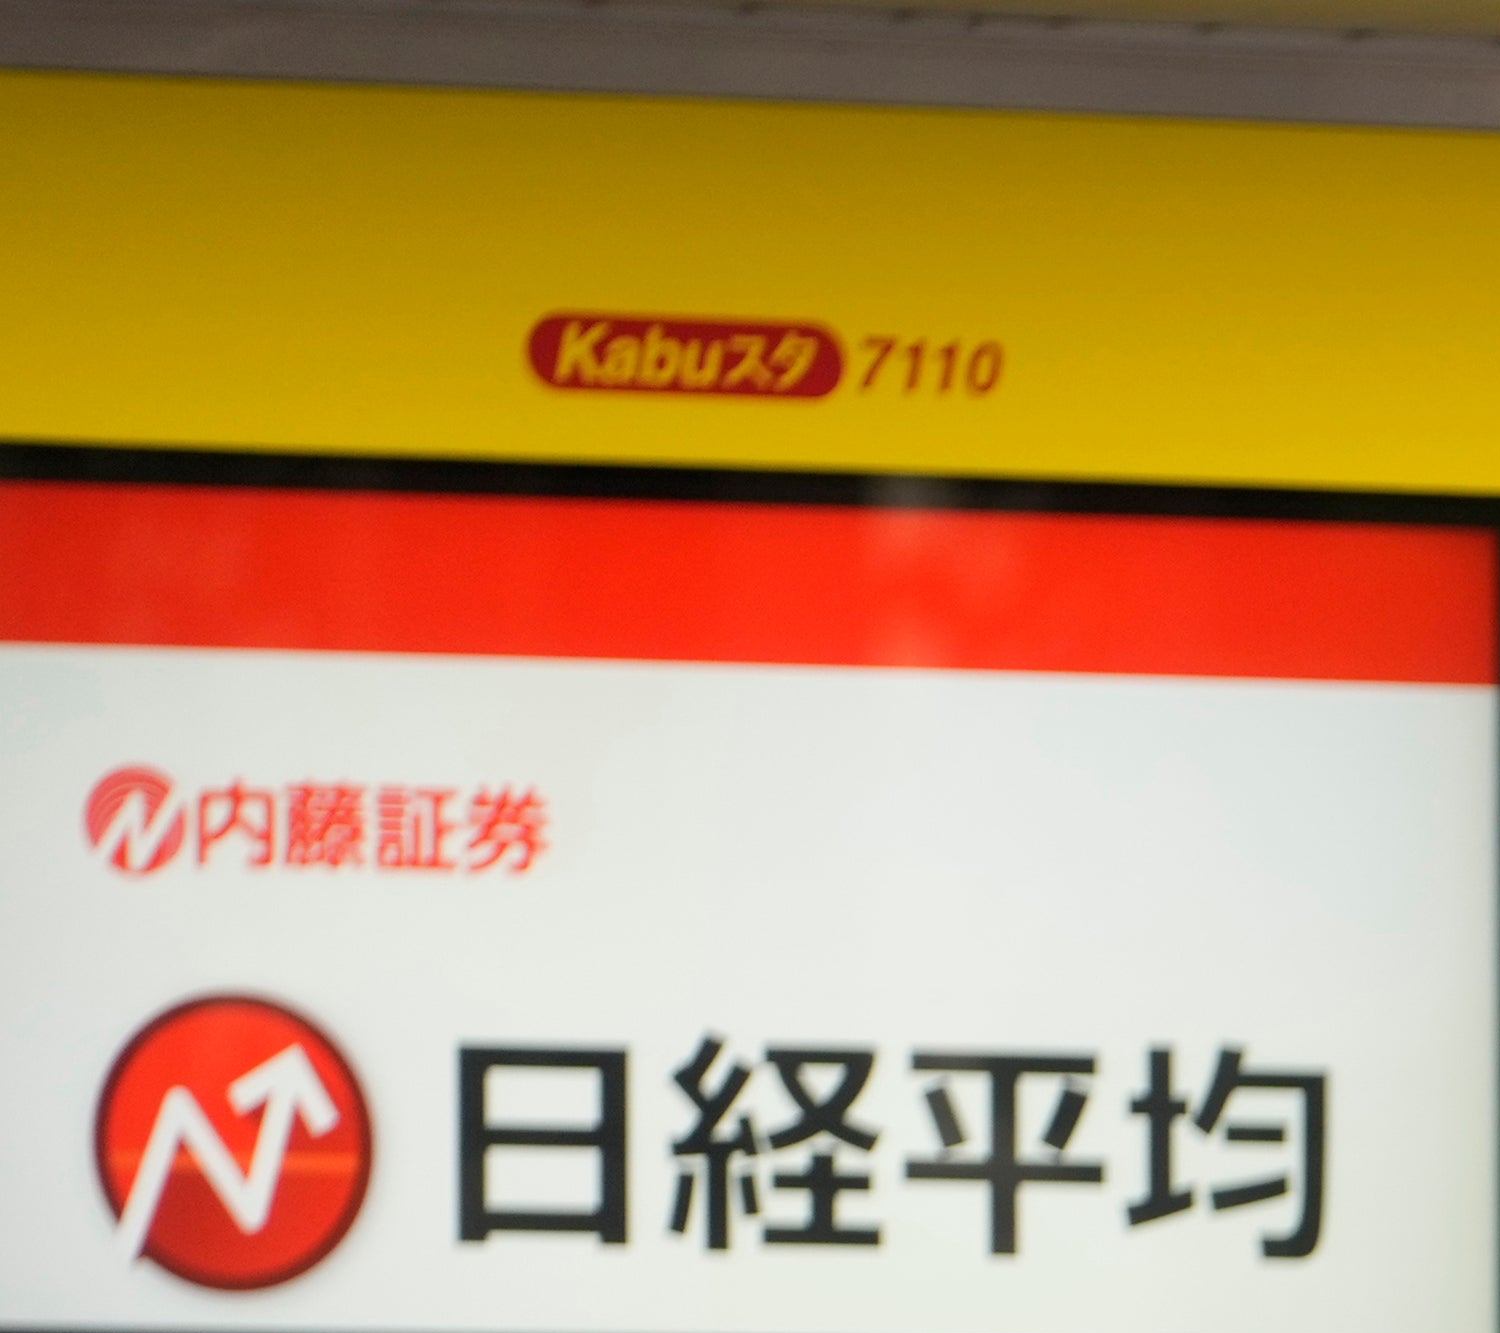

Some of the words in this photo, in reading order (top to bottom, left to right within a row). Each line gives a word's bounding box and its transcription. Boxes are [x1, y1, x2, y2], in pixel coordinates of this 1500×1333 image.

[858, 334, 1006, 398] 7110
[195, 782, 548, 876] 内藤証券
[456, 1034, 1331, 1261] 日経平均
